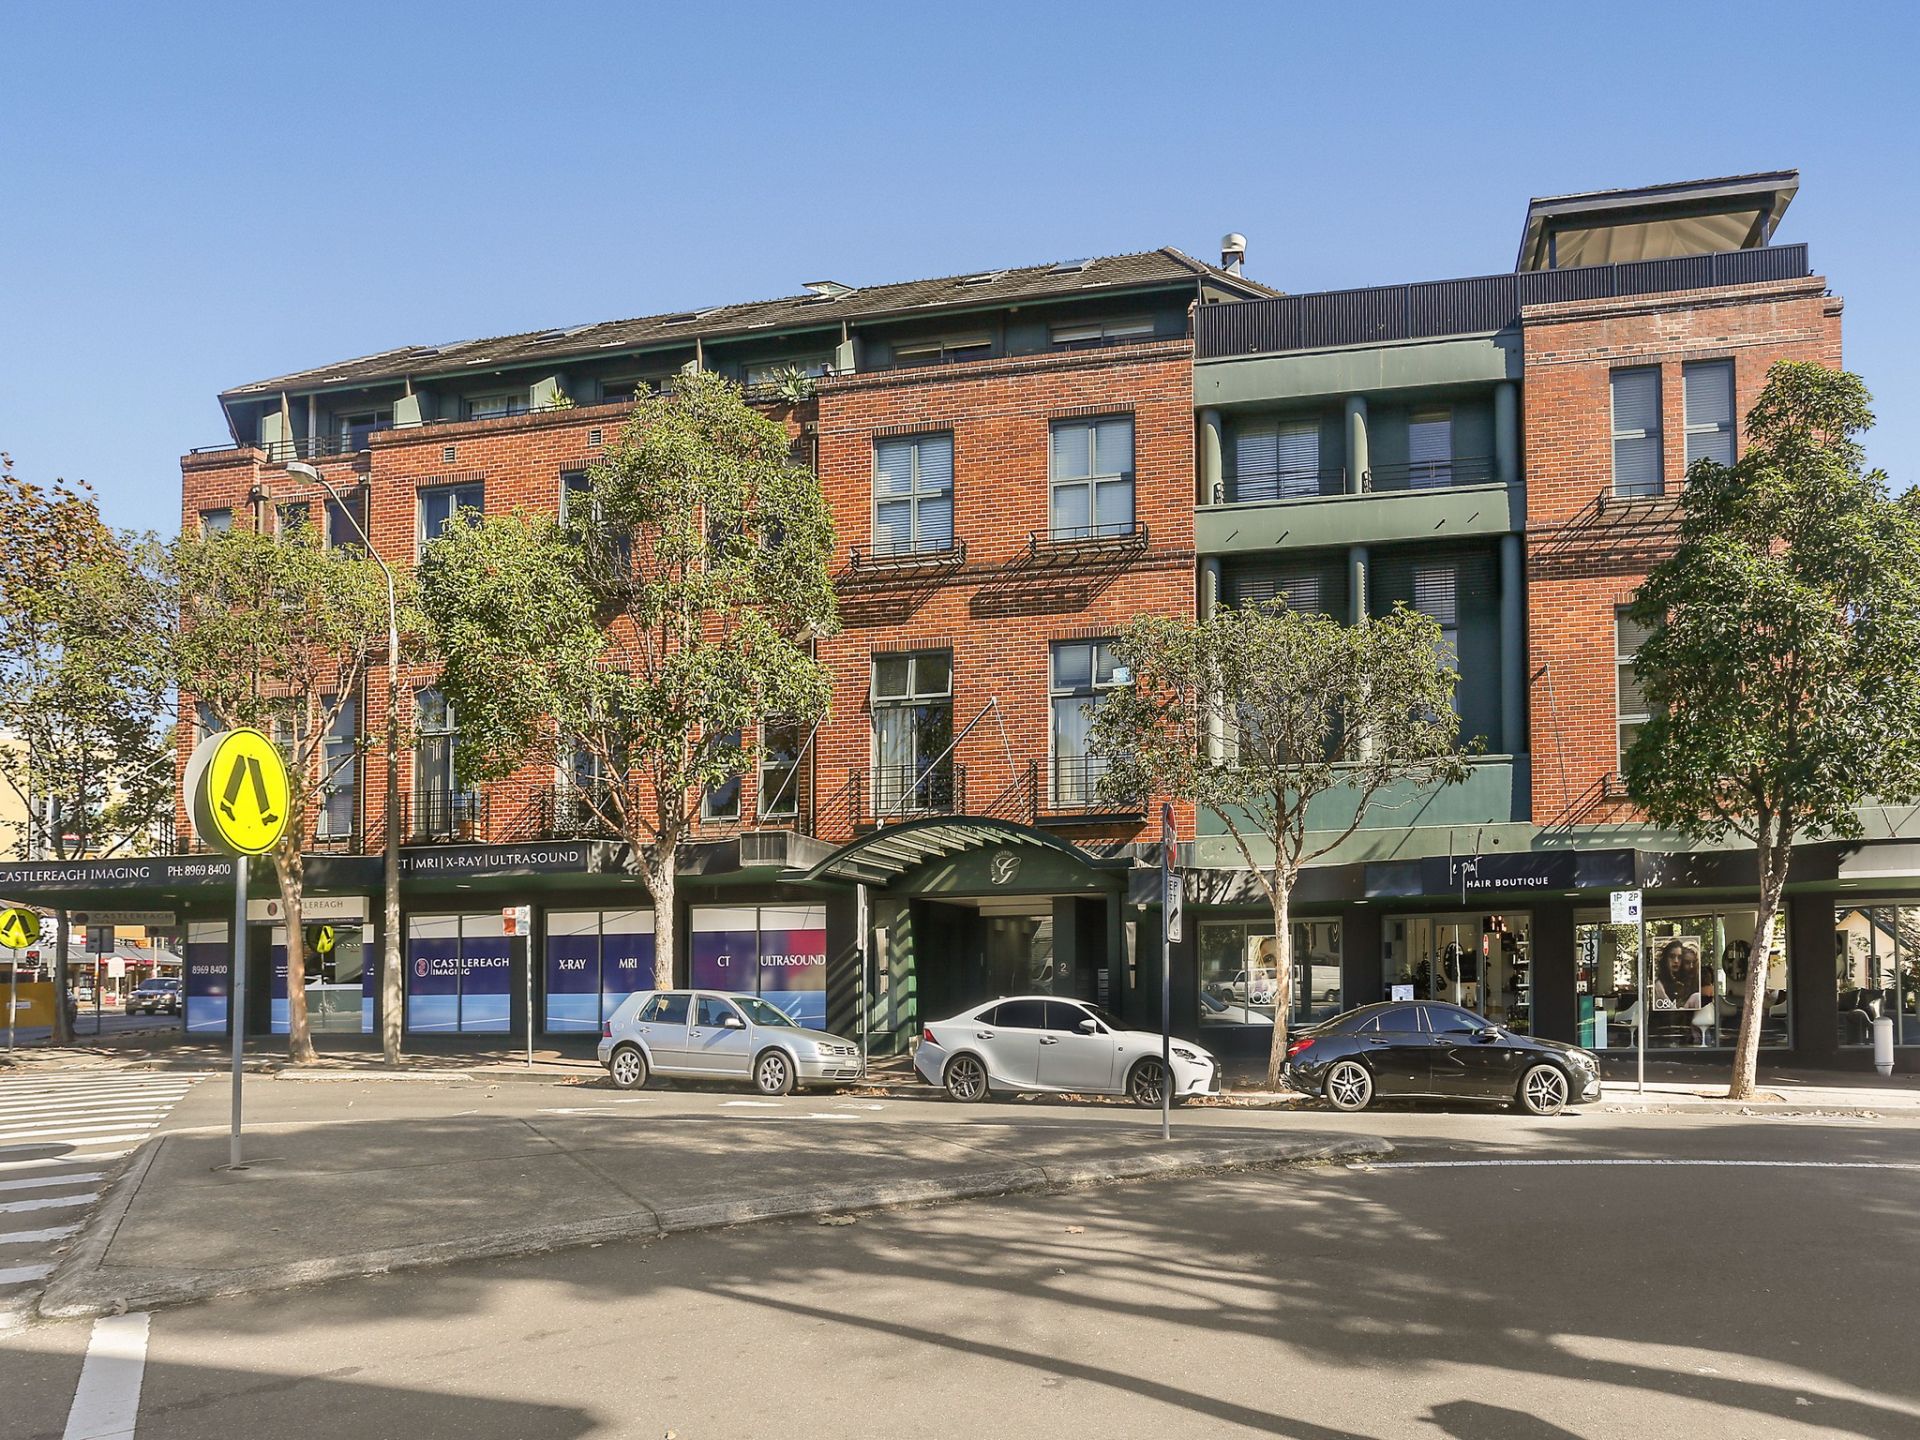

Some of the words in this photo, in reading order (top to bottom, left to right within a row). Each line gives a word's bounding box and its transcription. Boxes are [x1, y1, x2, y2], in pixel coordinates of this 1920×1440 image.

[415, 858, 438, 868] MRI
[446, 856, 483, 867] X-RAY
[490, 851, 579, 865] ULTRASOUND
[0, 869, 86, 882] CASTLEREAGH
[90, 866, 150, 879] IMAGING
[167, 865, 183, 876] PH:
[184, 864, 206, 876] 8969
[207, 863, 231, 875] 8400
[1466, 879, 1492, 888] HAIR
[1495, 876, 1549, 887] BOUTIQUE
[1628, 892, 1639, 902] 2P
[433, 958, 510, 968] CASTLEREAGH
[559, 959, 587, 970] X-RAY
[618, 958, 638, 969] MRI
[717, 956, 731, 967] CT
[760, 954, 826, 966] ULTRASOUND
[192, 965, 209, 974] 8969
[210, 965, 228, 974] 8400
